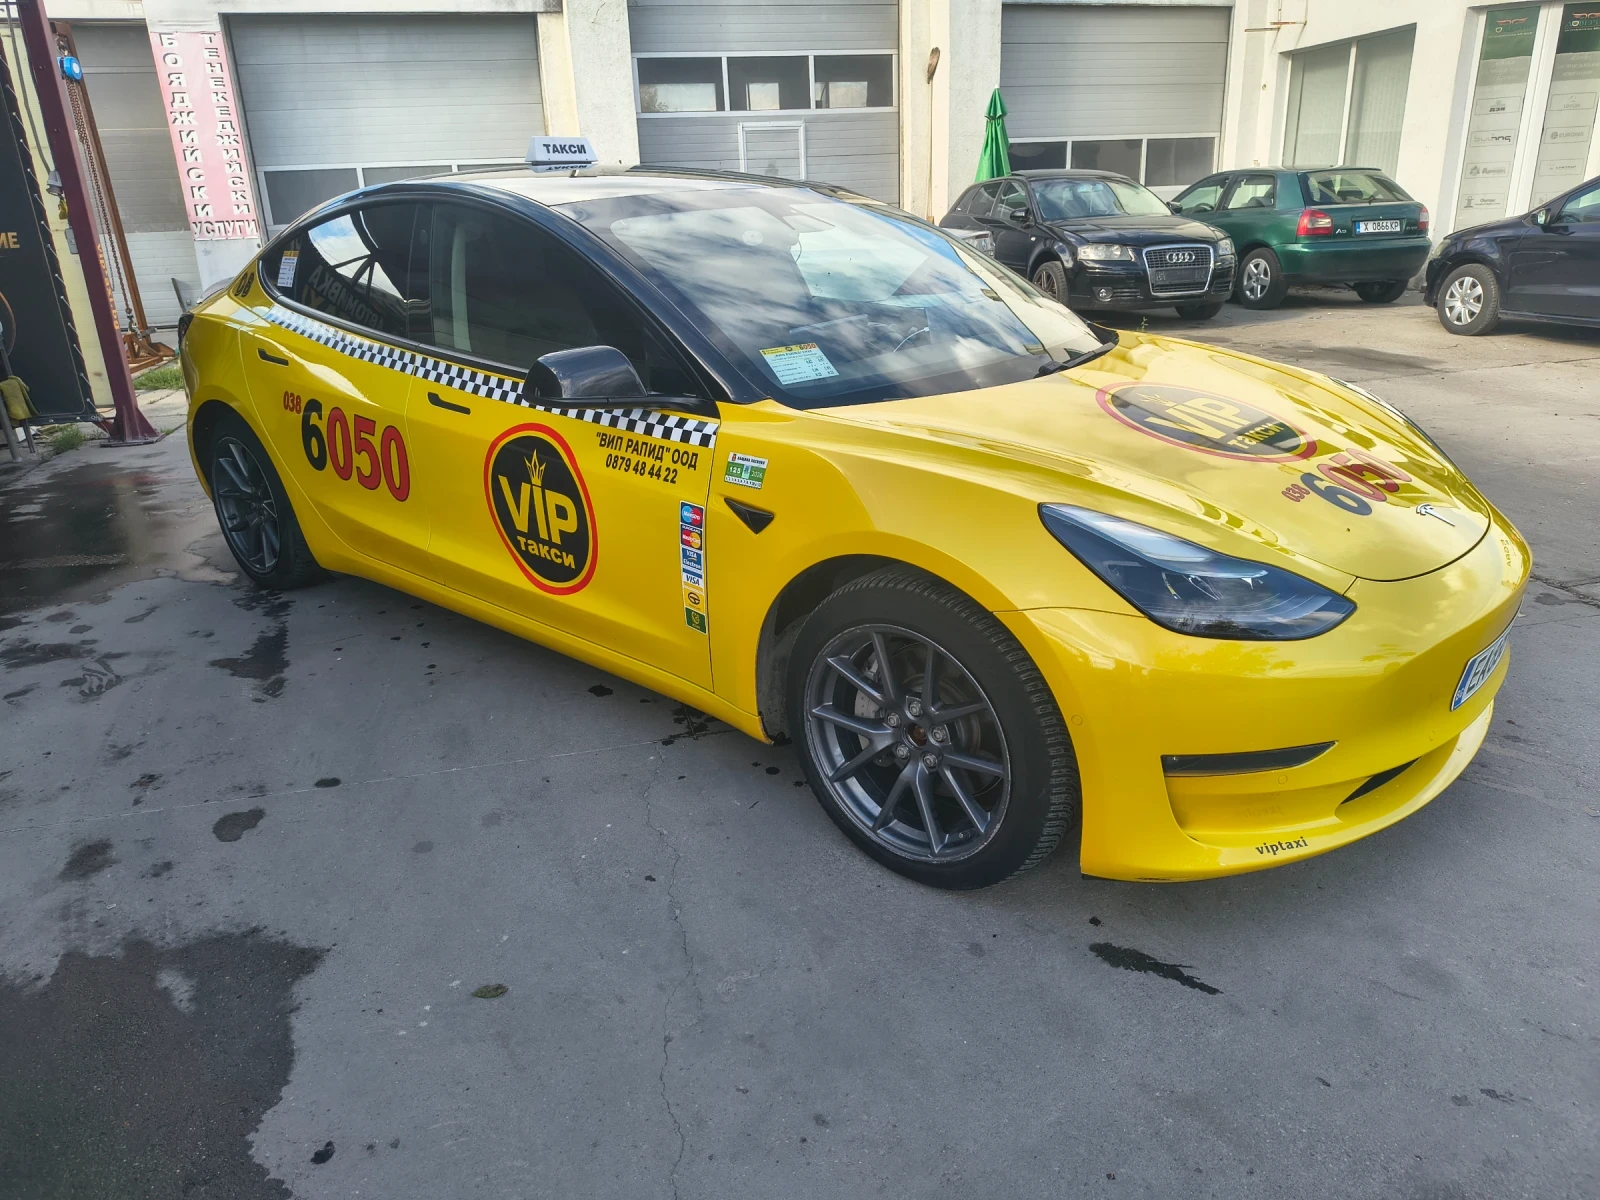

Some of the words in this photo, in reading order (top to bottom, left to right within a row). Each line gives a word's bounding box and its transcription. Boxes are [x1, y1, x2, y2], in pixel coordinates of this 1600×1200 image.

[158, 32, 214, 218] БОЯДЖИЙСКИ
[200, 32, 251, 216] ТЕНЕКЕДЖИЙСКИ
[543, 143, 587, 154] ТАКСИ
[1144, 397, 1252, 440] VIP
[1226, 422, 1285, 450] такси
[283, 390, 302, 414] 038
[301, 398, 411, 502] 6050
[596, 431, 623, 451] "ВИП
[625, 438, 671, 463] РАПИД"
[671, 448, 699, 471] ООД
[605, 453, 632, 472] 0879
[632, 460, 647, 476] 48
[647, 463, 662, 480] 44
[662, 467, 678, 484] 22
[1281, 483, 1311, 503] 038
[1300, 448, 1412, 516] 6050
[498, 474, 578, 545] VIP
[516, 535, 576, 569] такси
[686, 549, 697, 559] VISA
[686, 574, 700, 586] VISA
[1255, 836, 1309, 855] viptaxi
